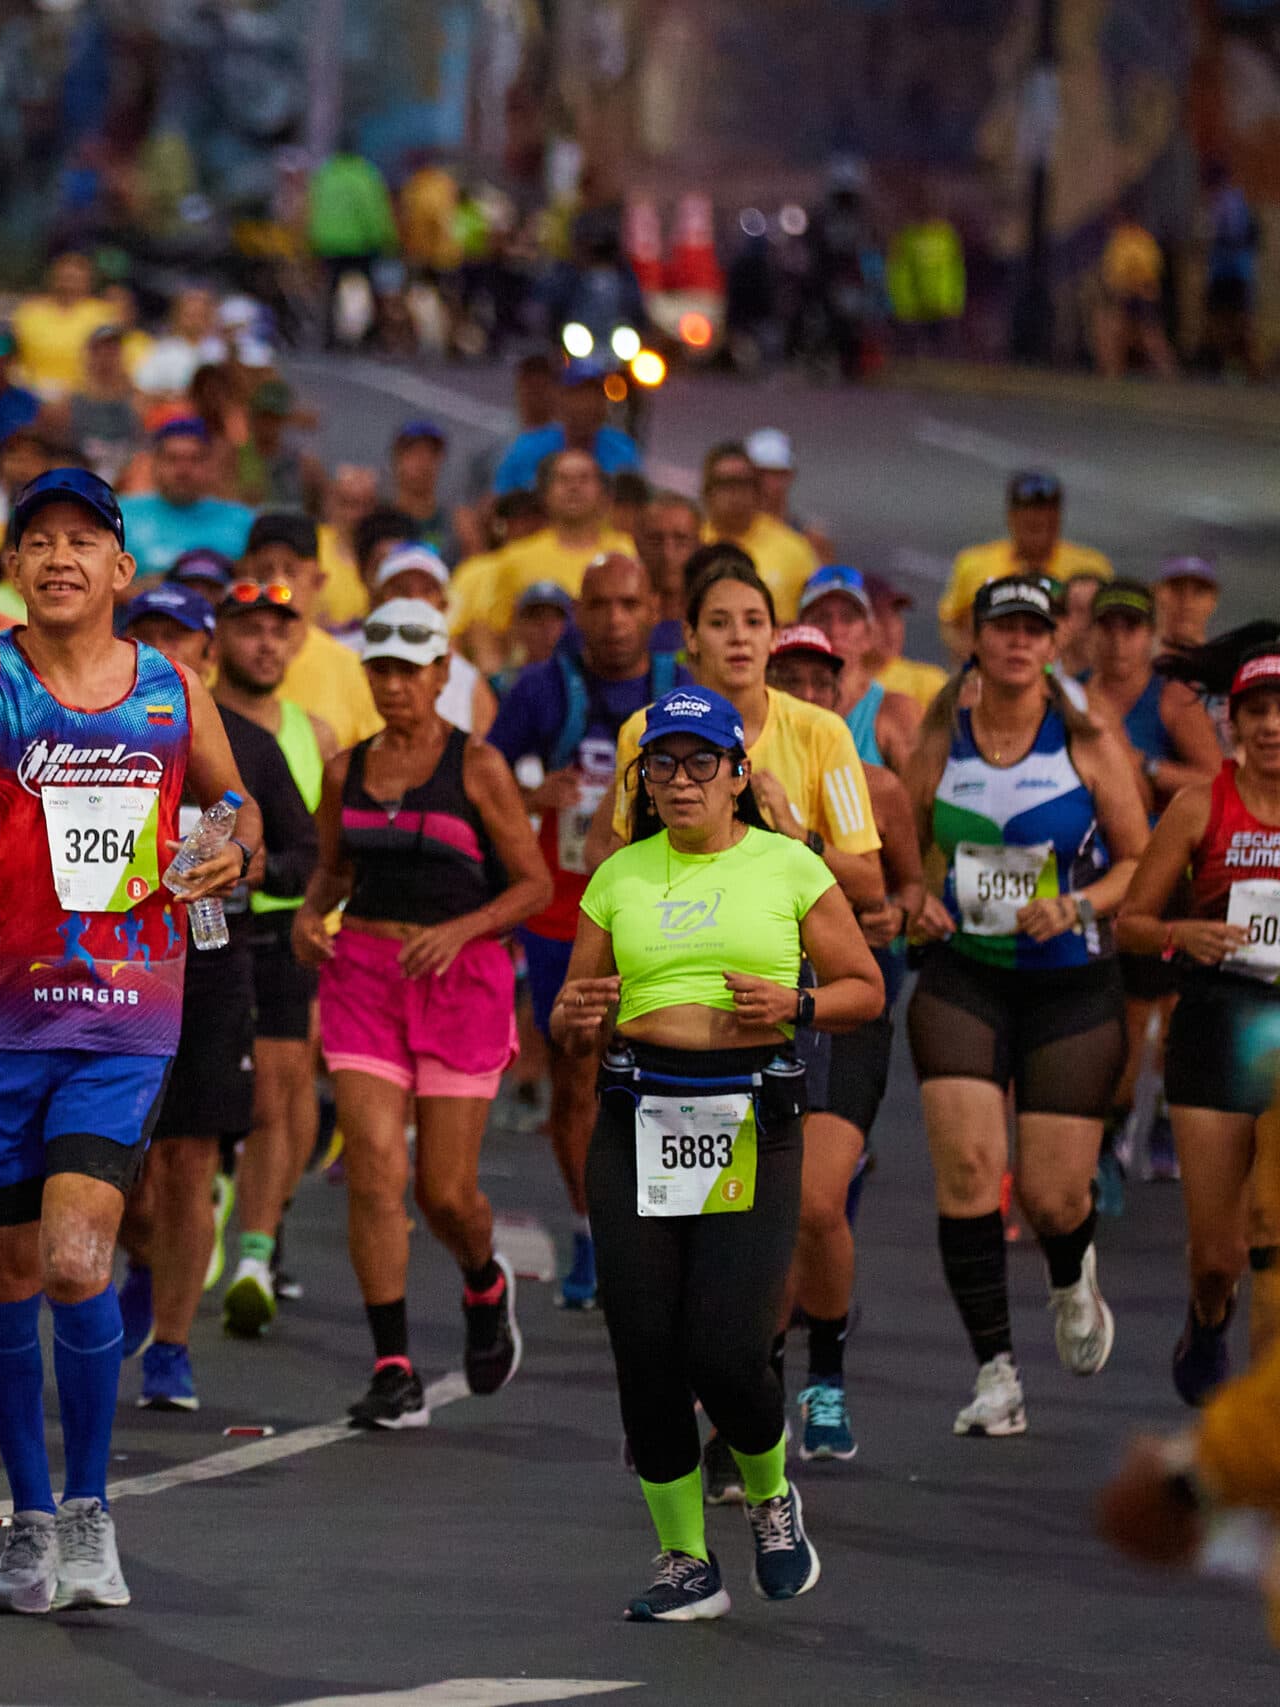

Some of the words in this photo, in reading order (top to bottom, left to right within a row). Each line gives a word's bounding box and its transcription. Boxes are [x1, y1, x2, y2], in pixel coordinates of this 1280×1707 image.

[36, 764, 163, 784] Runners
[65, 828, 136, 864] 3264
[132, 881, 141, 897] B
[978, 870, 1037, 900] 5936
[1248, 914, 1280, 945] 50
[33, 986, 139, 1004] MONAGAS
[662, 1133, 733, 1169] 5883
[729, 1183, 737, 1198] E
